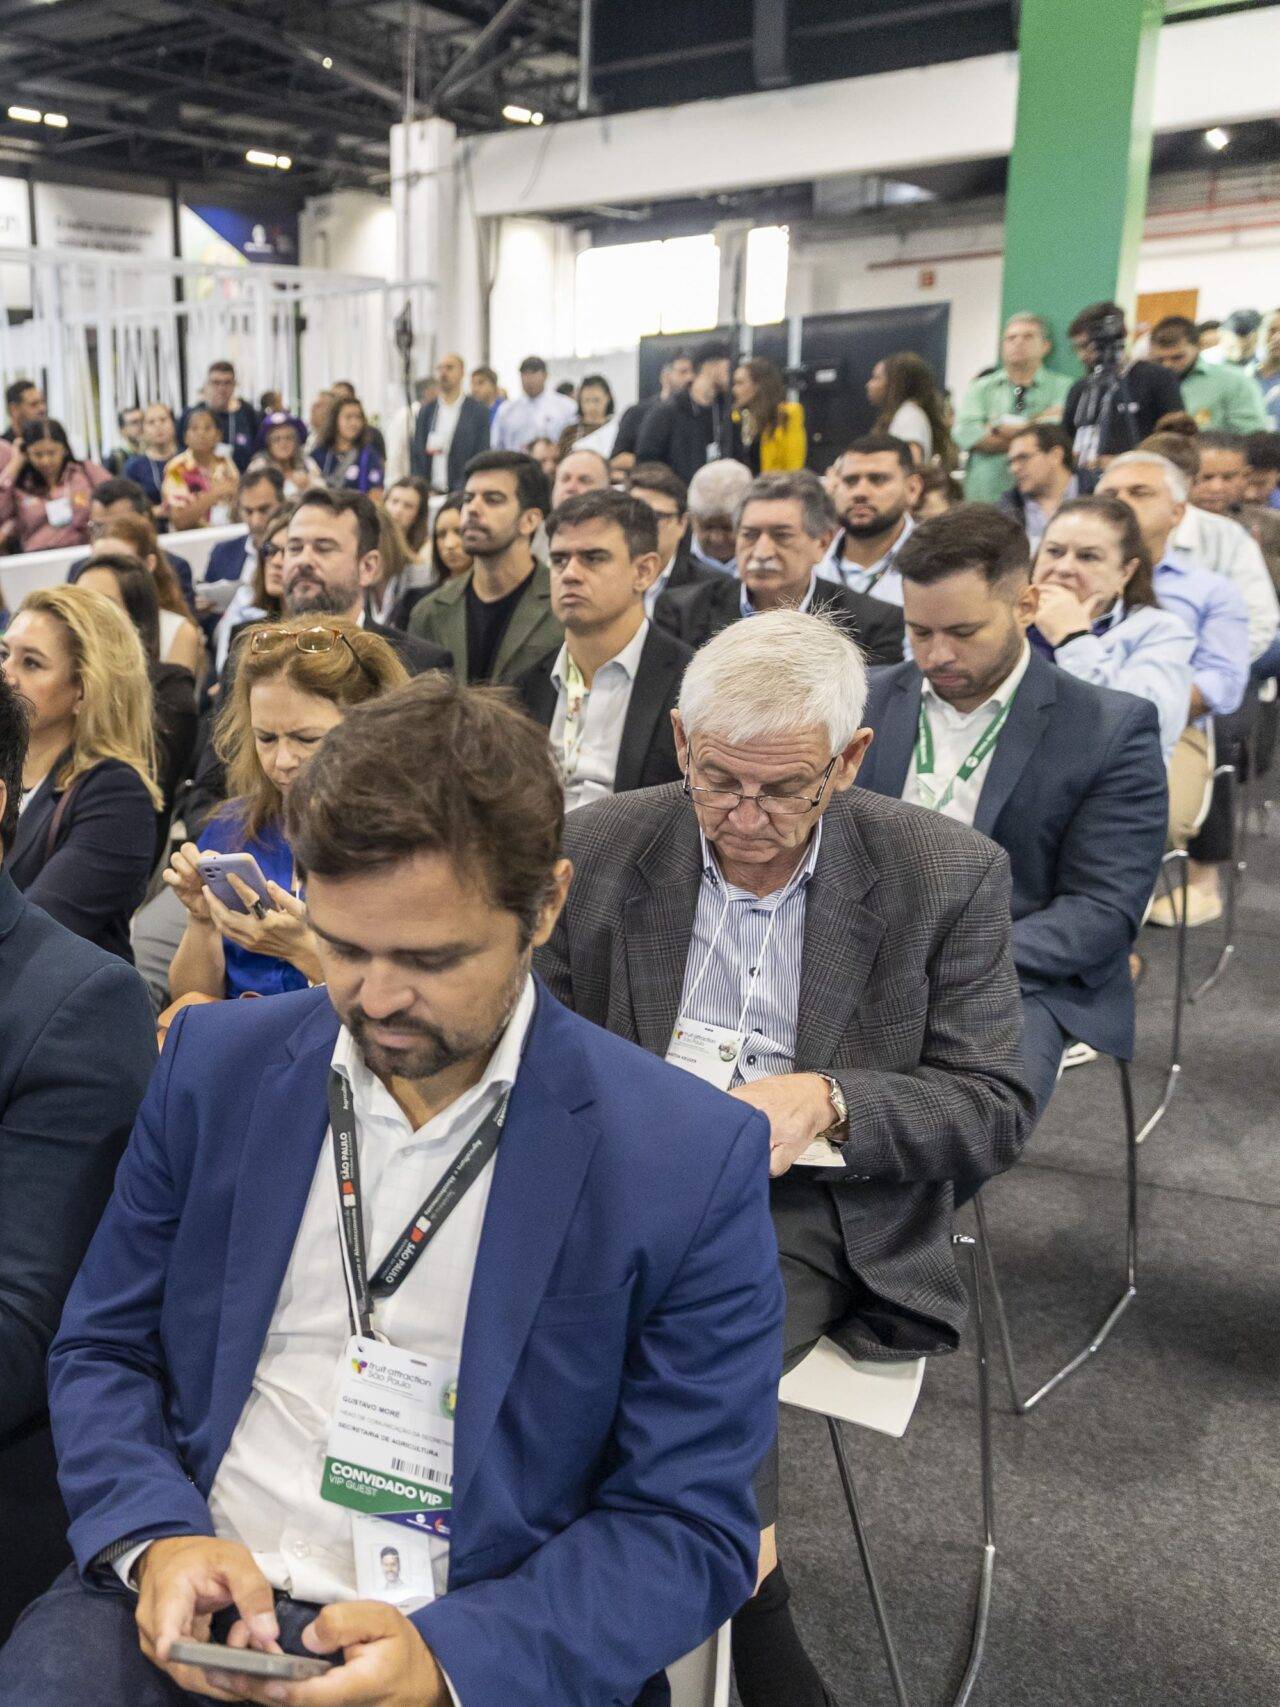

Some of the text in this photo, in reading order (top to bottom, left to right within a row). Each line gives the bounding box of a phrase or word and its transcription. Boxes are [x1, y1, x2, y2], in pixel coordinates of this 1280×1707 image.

[339, 1132, 349, 1162] PAULO
[400, 1242, 417, 1260] SÃO
[386, 1257, 406, 1284] PAULO
[387, 1368, 432, 1387] attraction
[342, 1395, 378, 1412] GUSTAVO
[329, 1475, 379, 1498] VIP GUEST
[330, 1462, 443, 1507] CONVIDADO VIP
